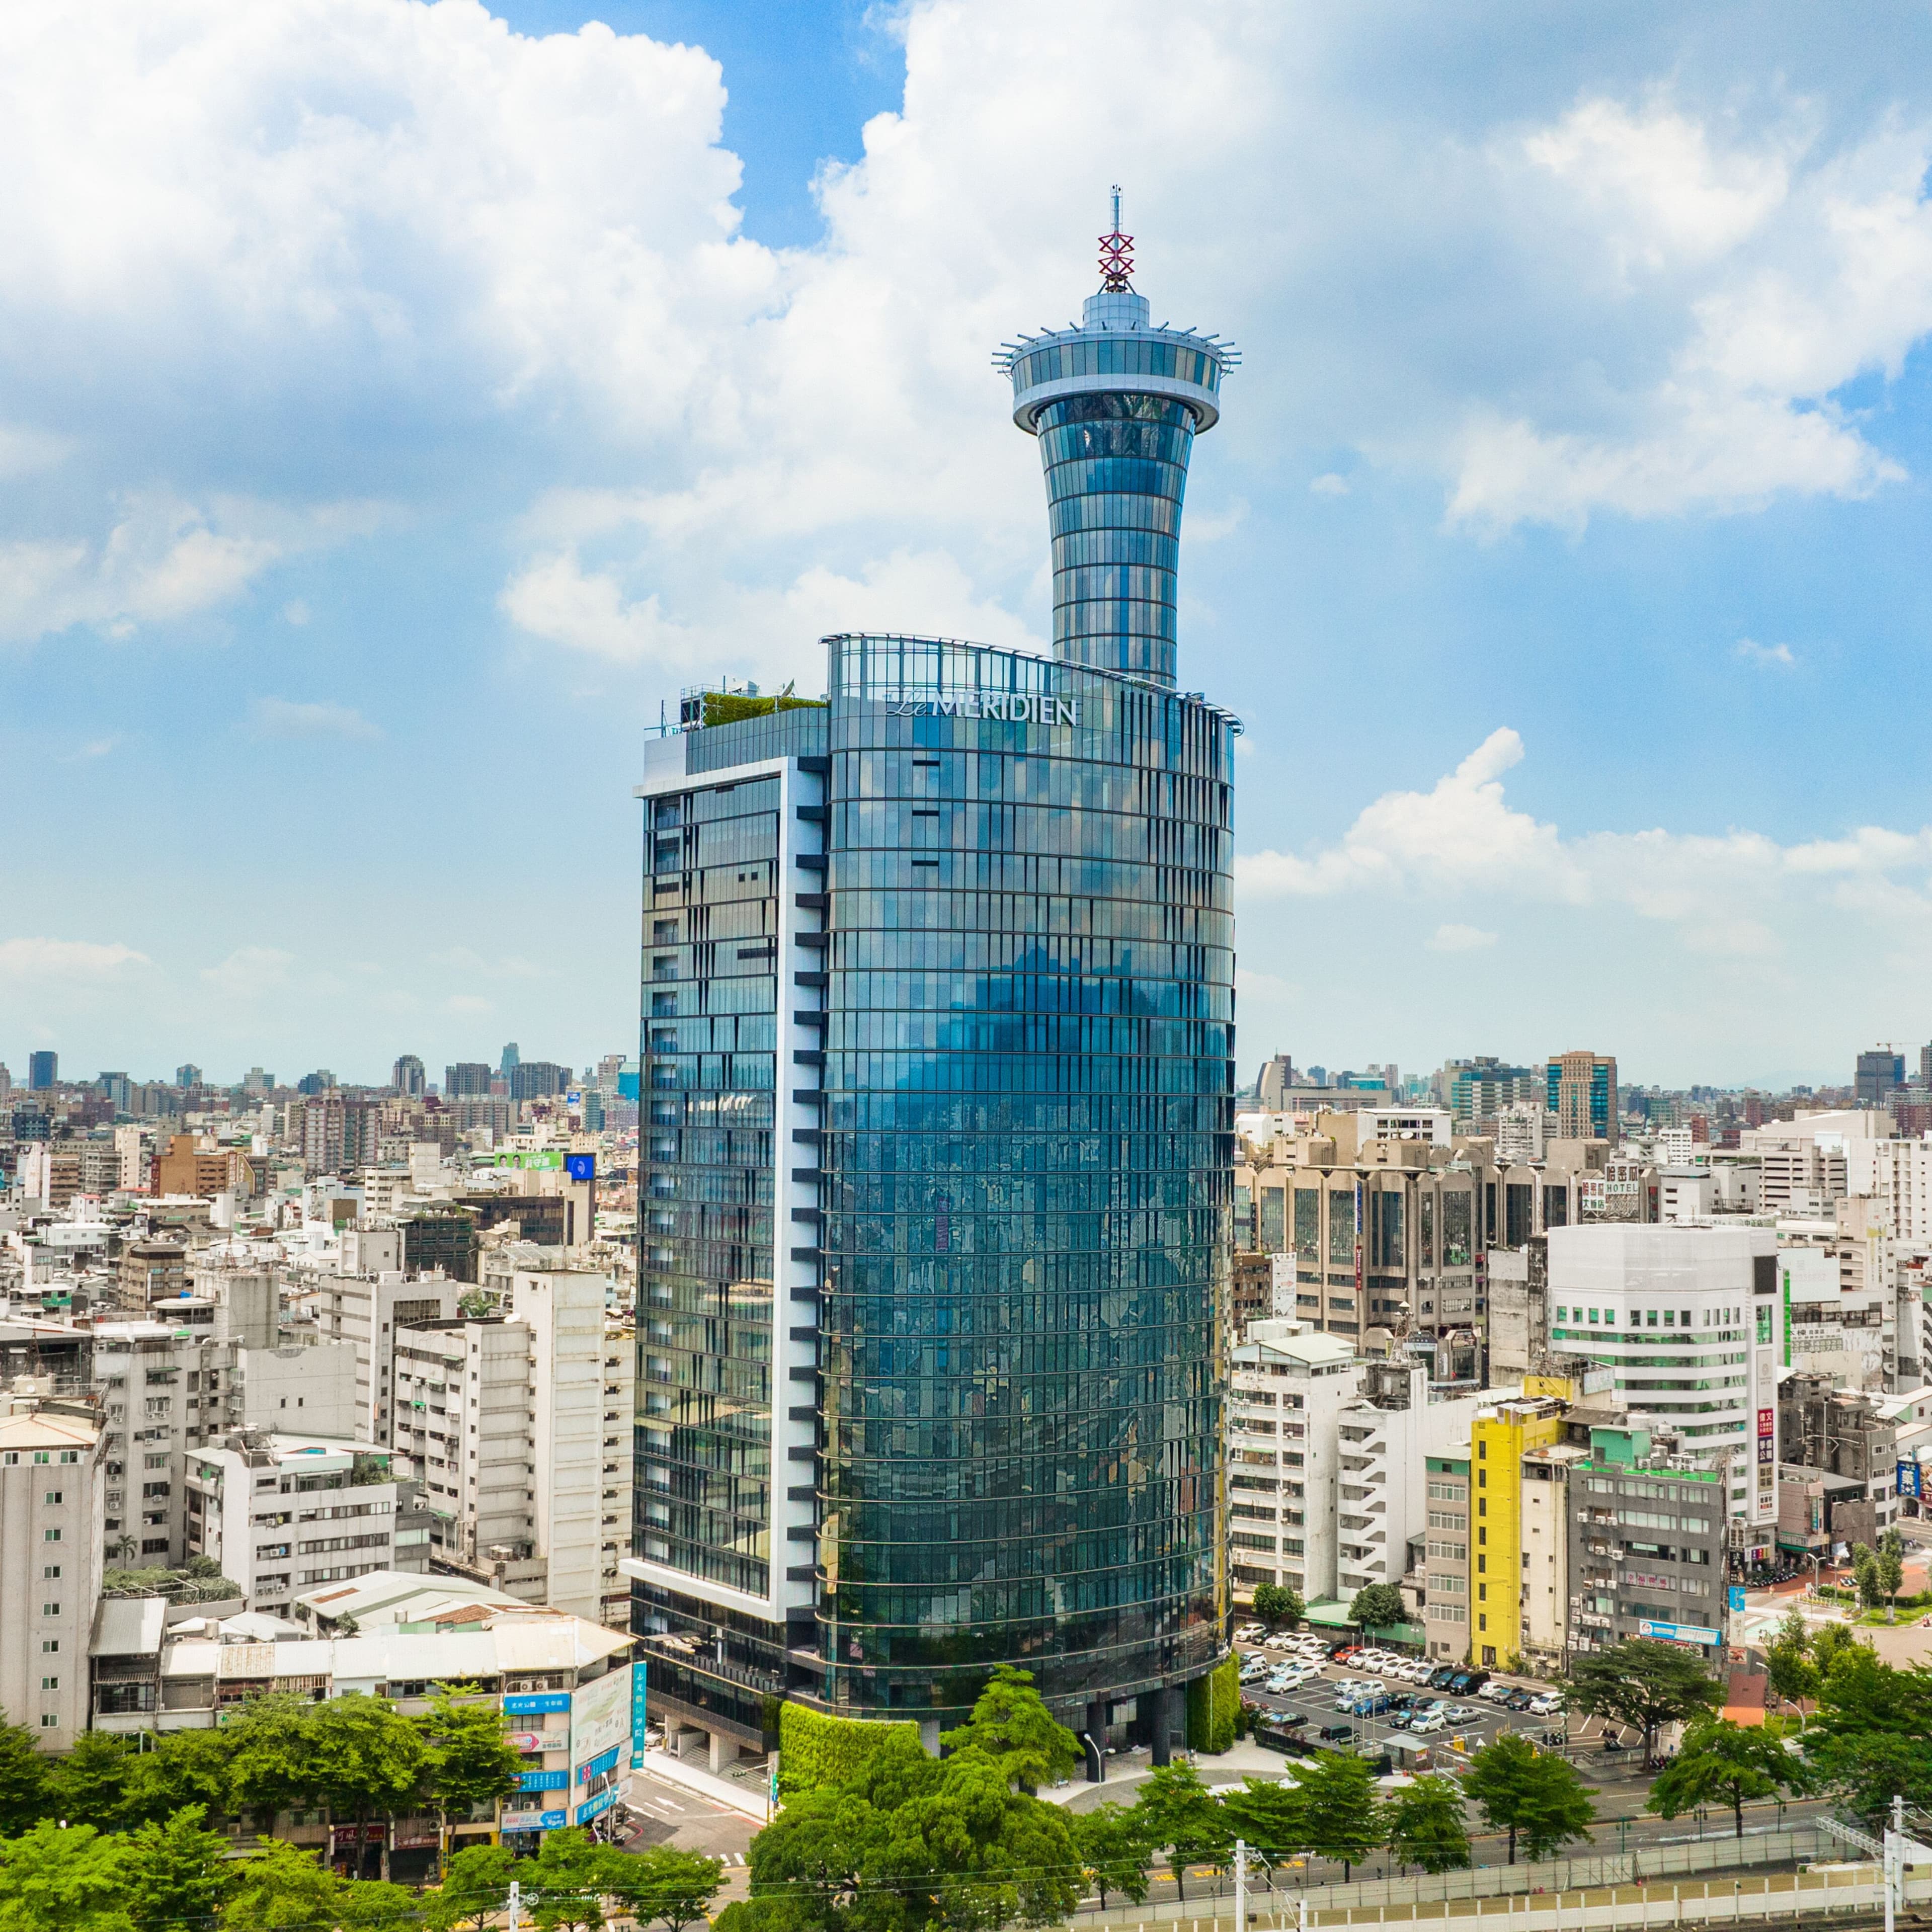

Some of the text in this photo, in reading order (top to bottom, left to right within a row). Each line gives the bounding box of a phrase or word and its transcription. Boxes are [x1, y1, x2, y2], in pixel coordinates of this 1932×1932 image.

[886, 687, 927, 717] Le
[1606, 1166, 1638, 1181] 哈密瓜
[1606, 1184, 1638, 1192] HOTEL
